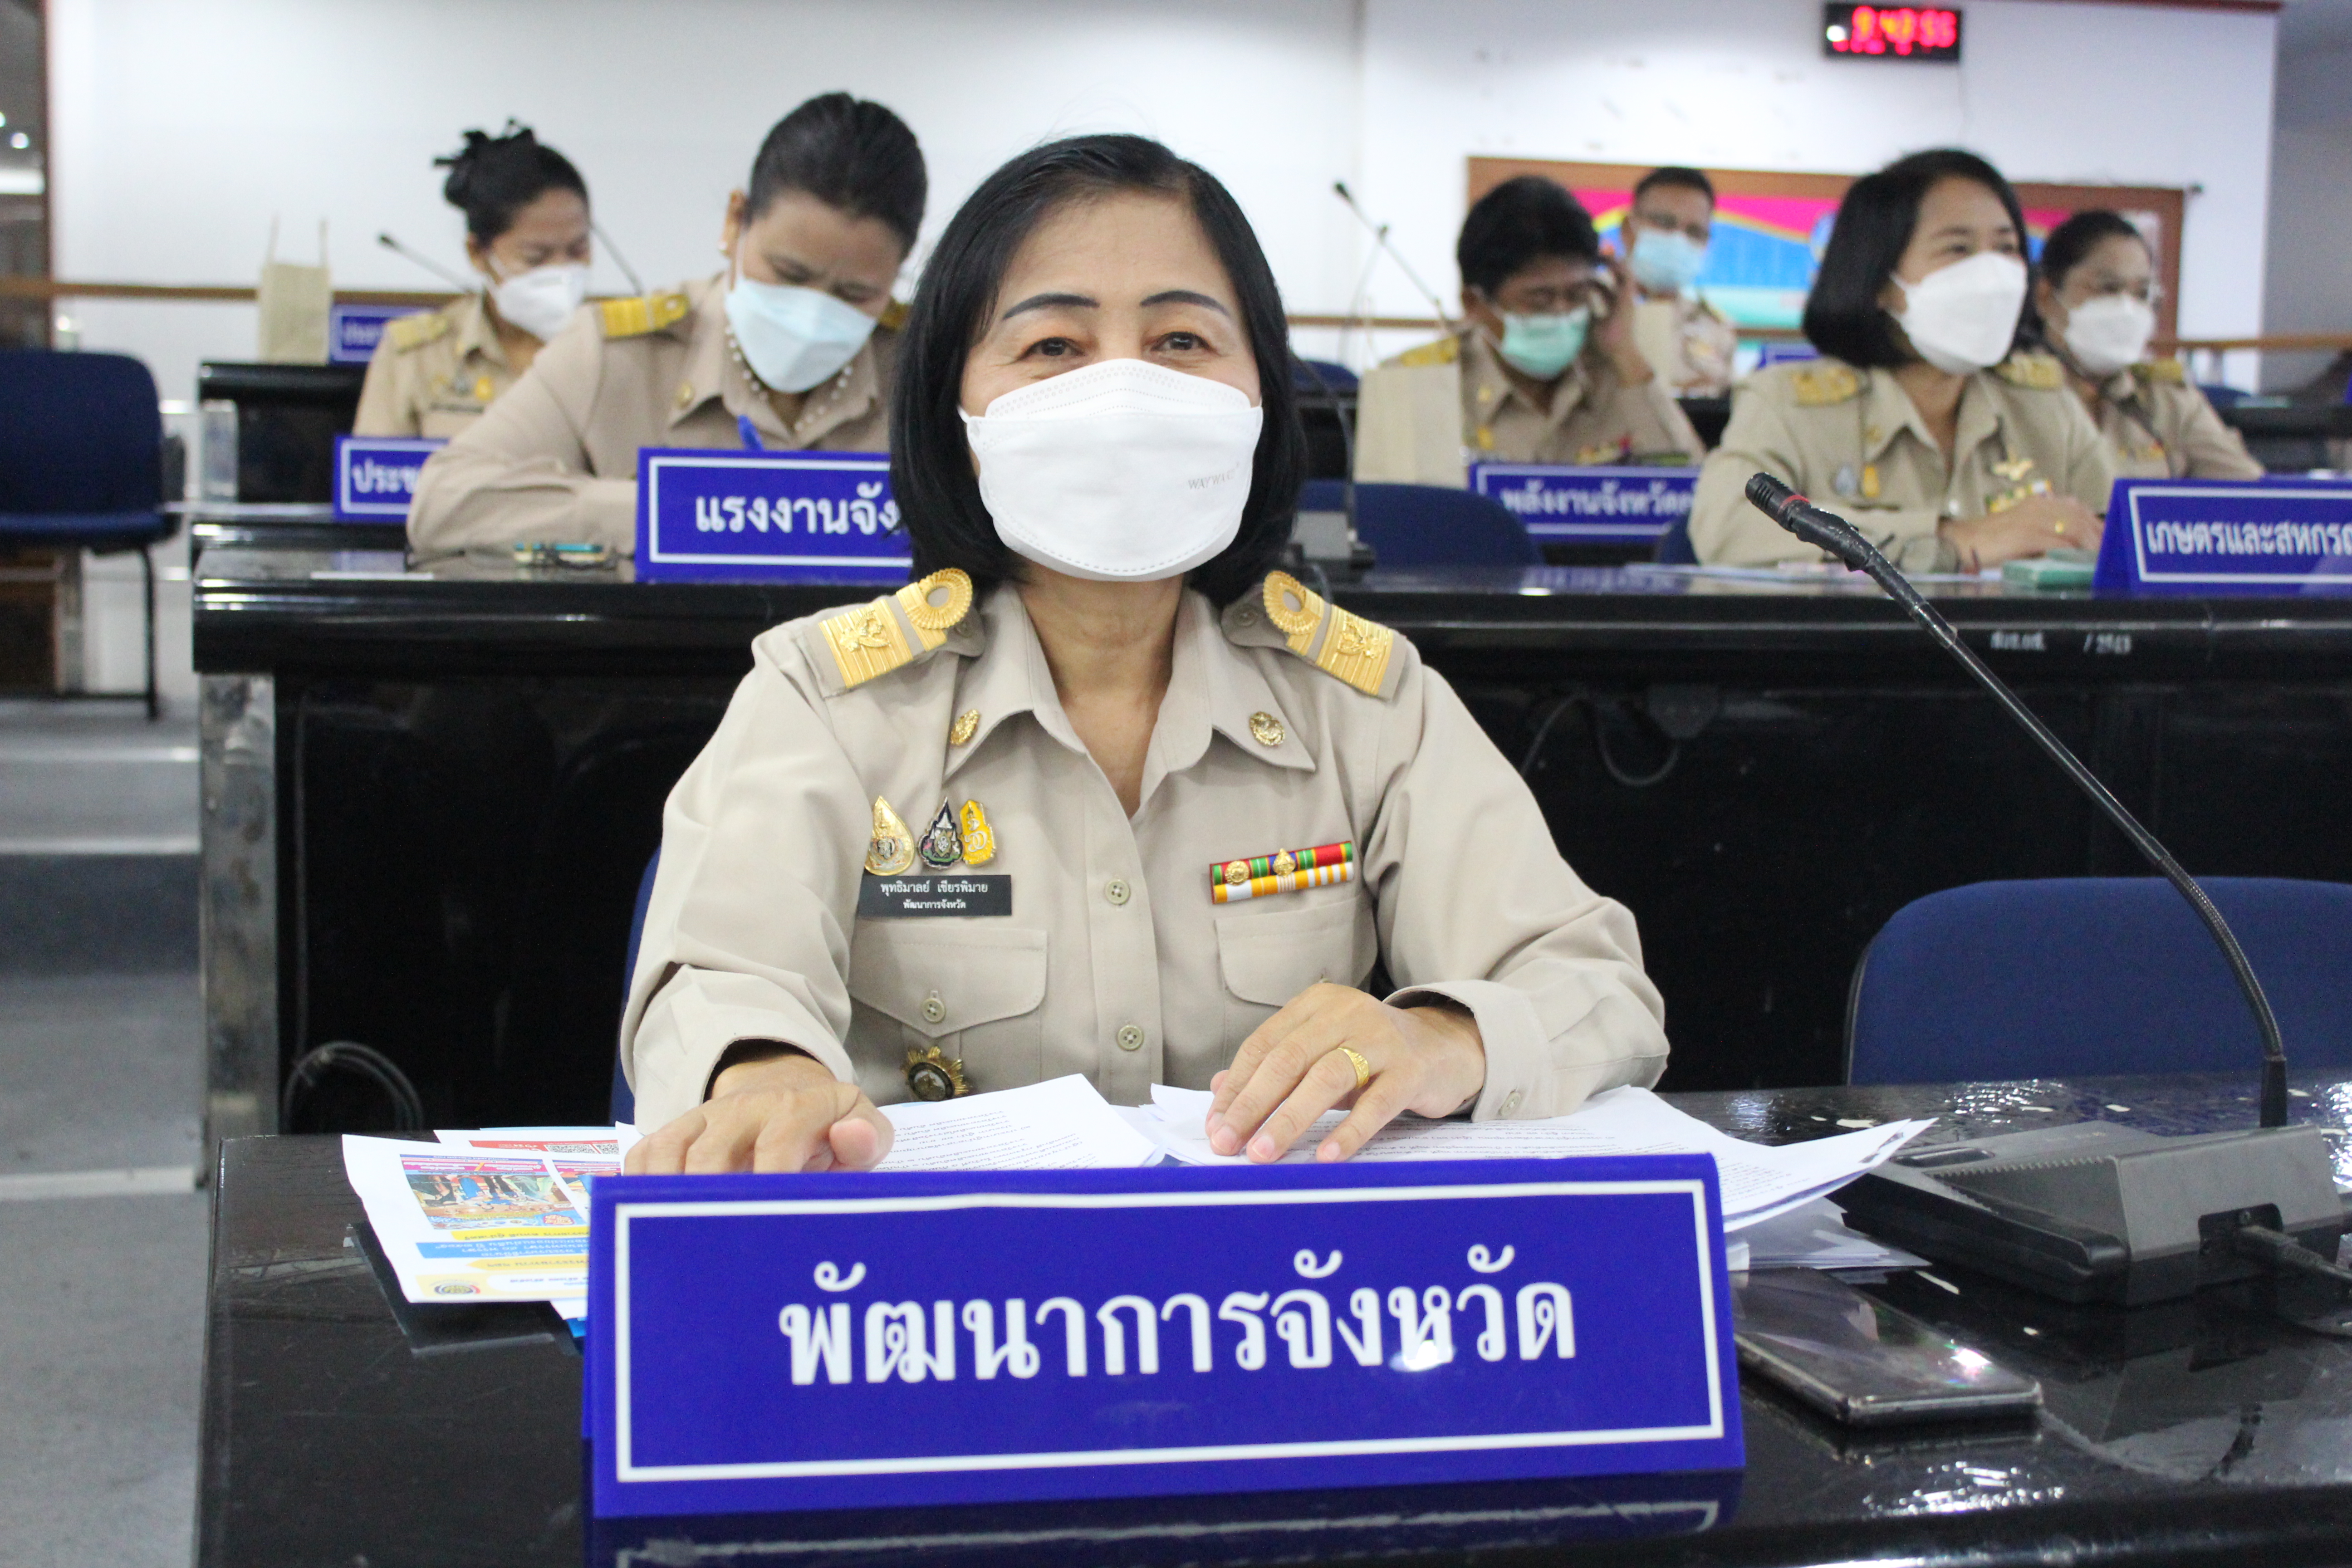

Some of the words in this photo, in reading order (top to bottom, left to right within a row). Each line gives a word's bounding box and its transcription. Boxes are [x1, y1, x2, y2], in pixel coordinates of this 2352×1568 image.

[902, 898, 966, 909] พัฒนาการจังหวัด
[779, 1244, 1576, 1386] พัฒนาการจังหวัด
